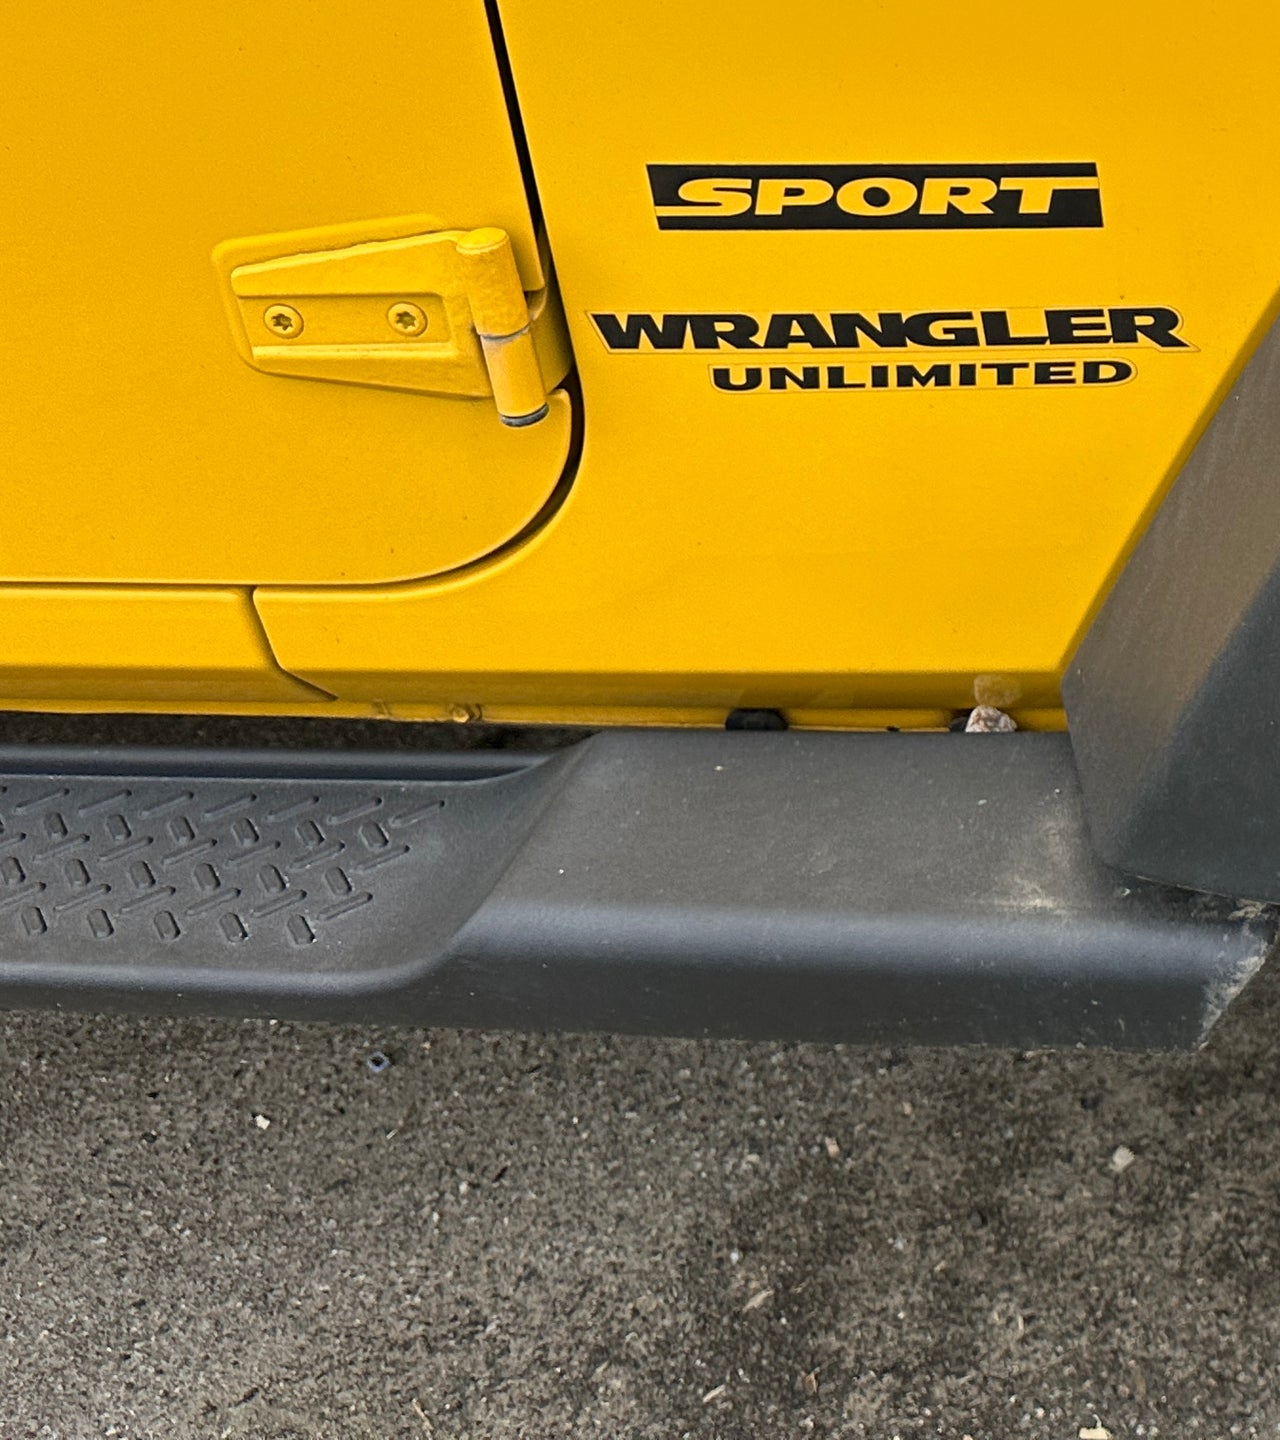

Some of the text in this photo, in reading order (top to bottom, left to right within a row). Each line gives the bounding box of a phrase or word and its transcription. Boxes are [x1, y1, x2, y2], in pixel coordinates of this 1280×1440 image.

[653, 176, 1099, 217] SPORT
[591, 306, 1198, 350] WRANGLER
[712, 360, 1133, 393] UNLIMITED
